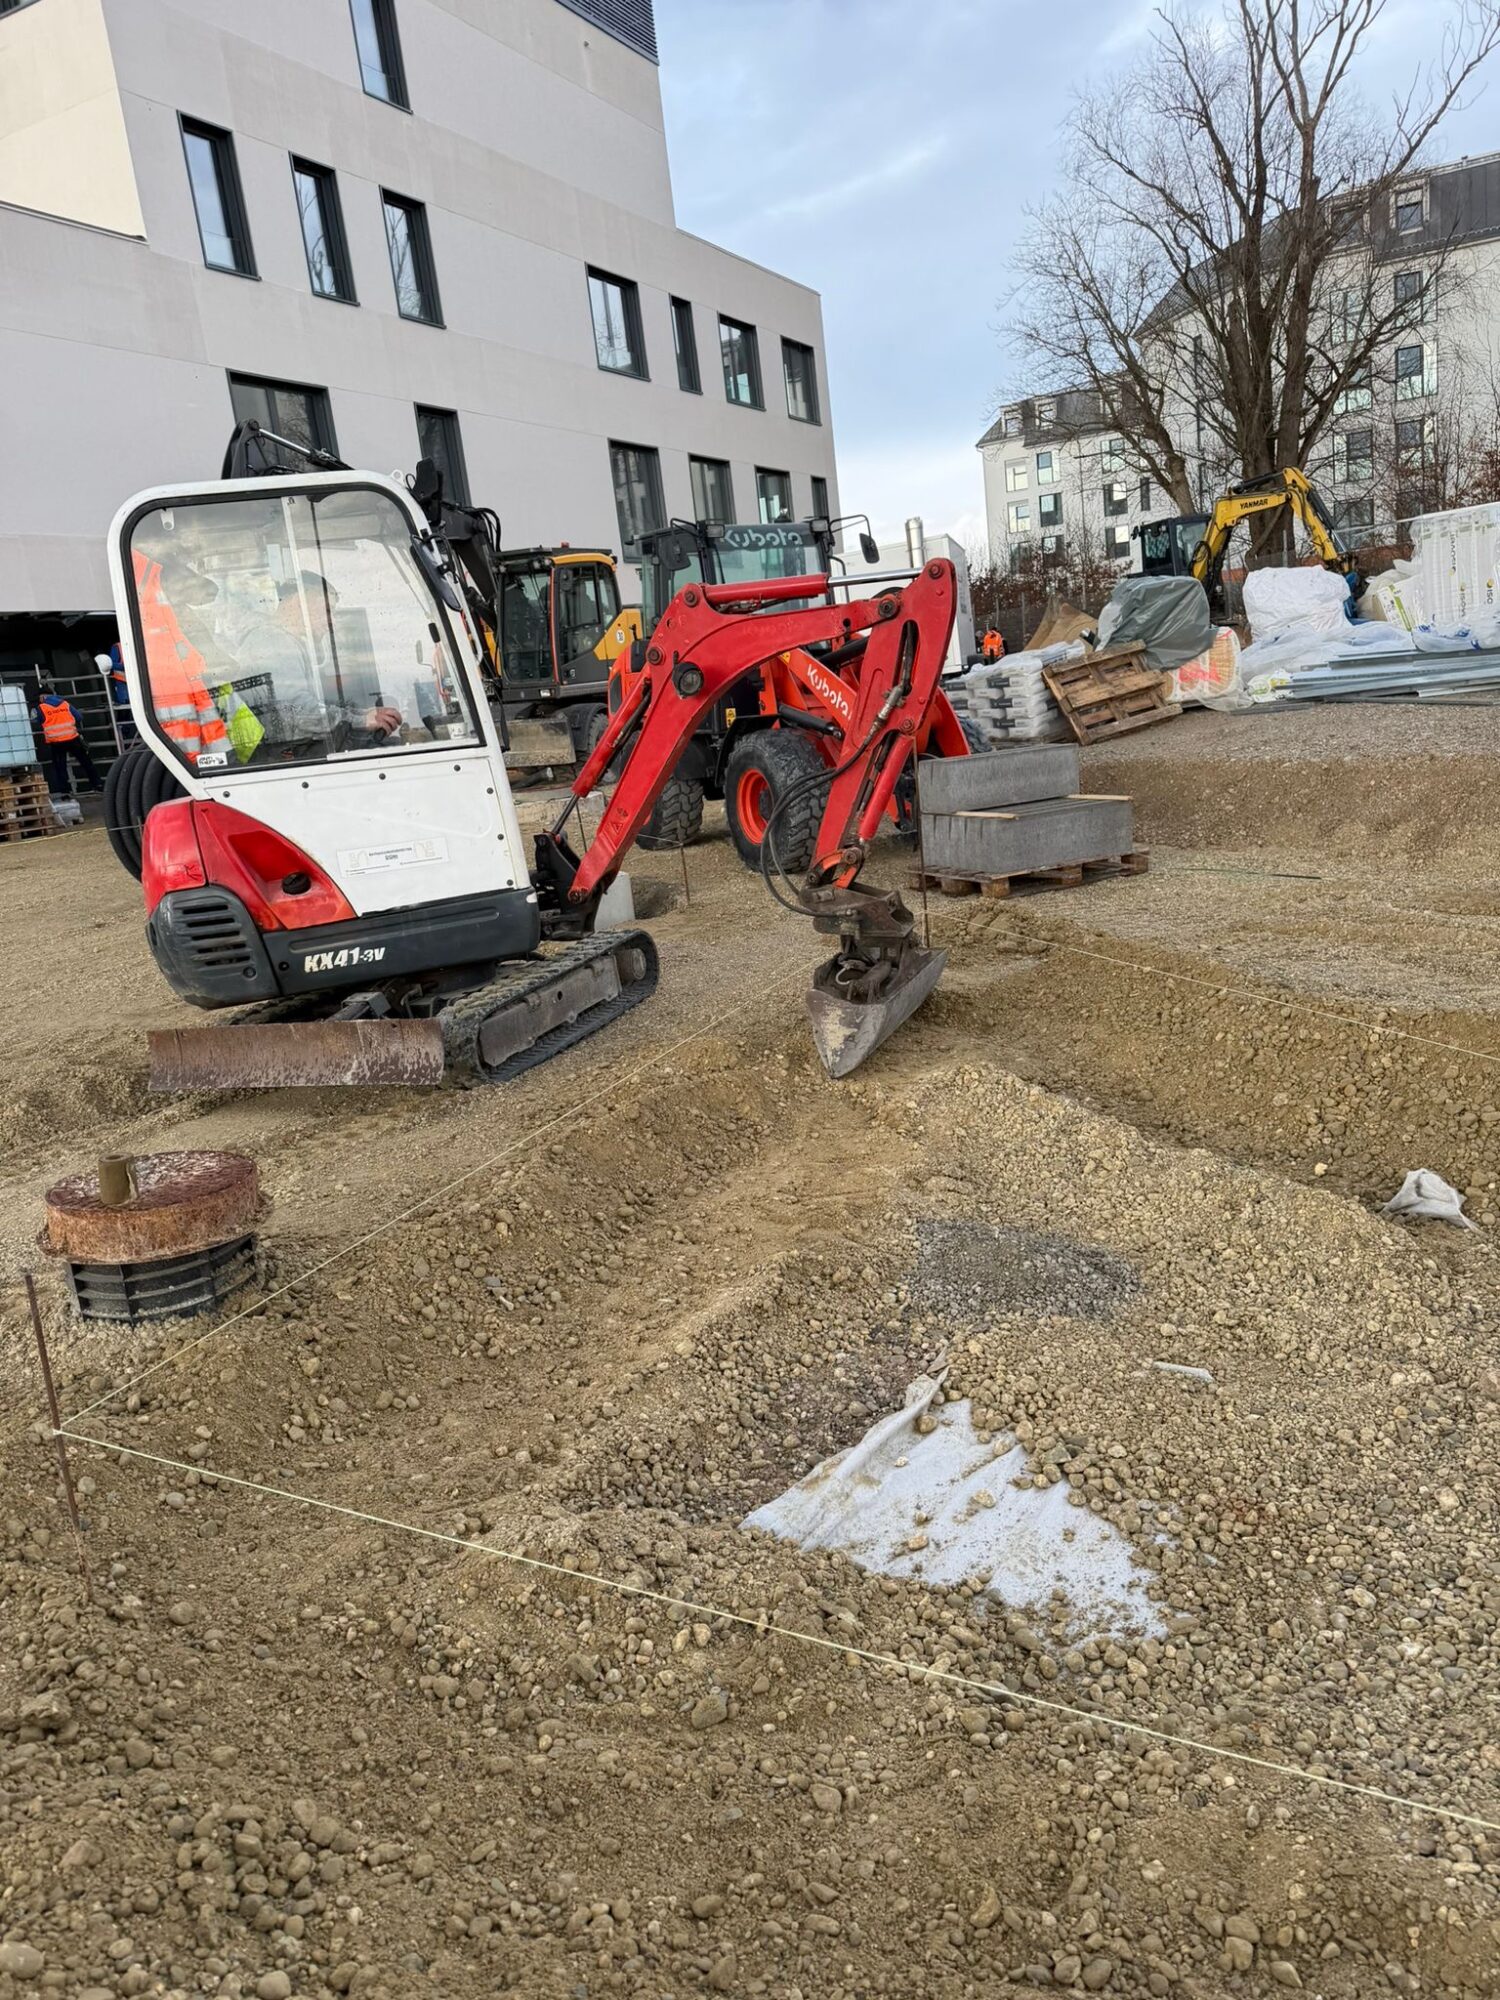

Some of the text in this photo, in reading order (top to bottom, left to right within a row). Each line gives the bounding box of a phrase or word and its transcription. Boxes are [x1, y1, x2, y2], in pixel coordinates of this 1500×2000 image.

[1240, 498, 1268, 510] YANMAR
[724, 528, 803, 548] Kubota
[807, 663, 849, 716] Kubota
[304, 946, 386, 973] KX41-3V
